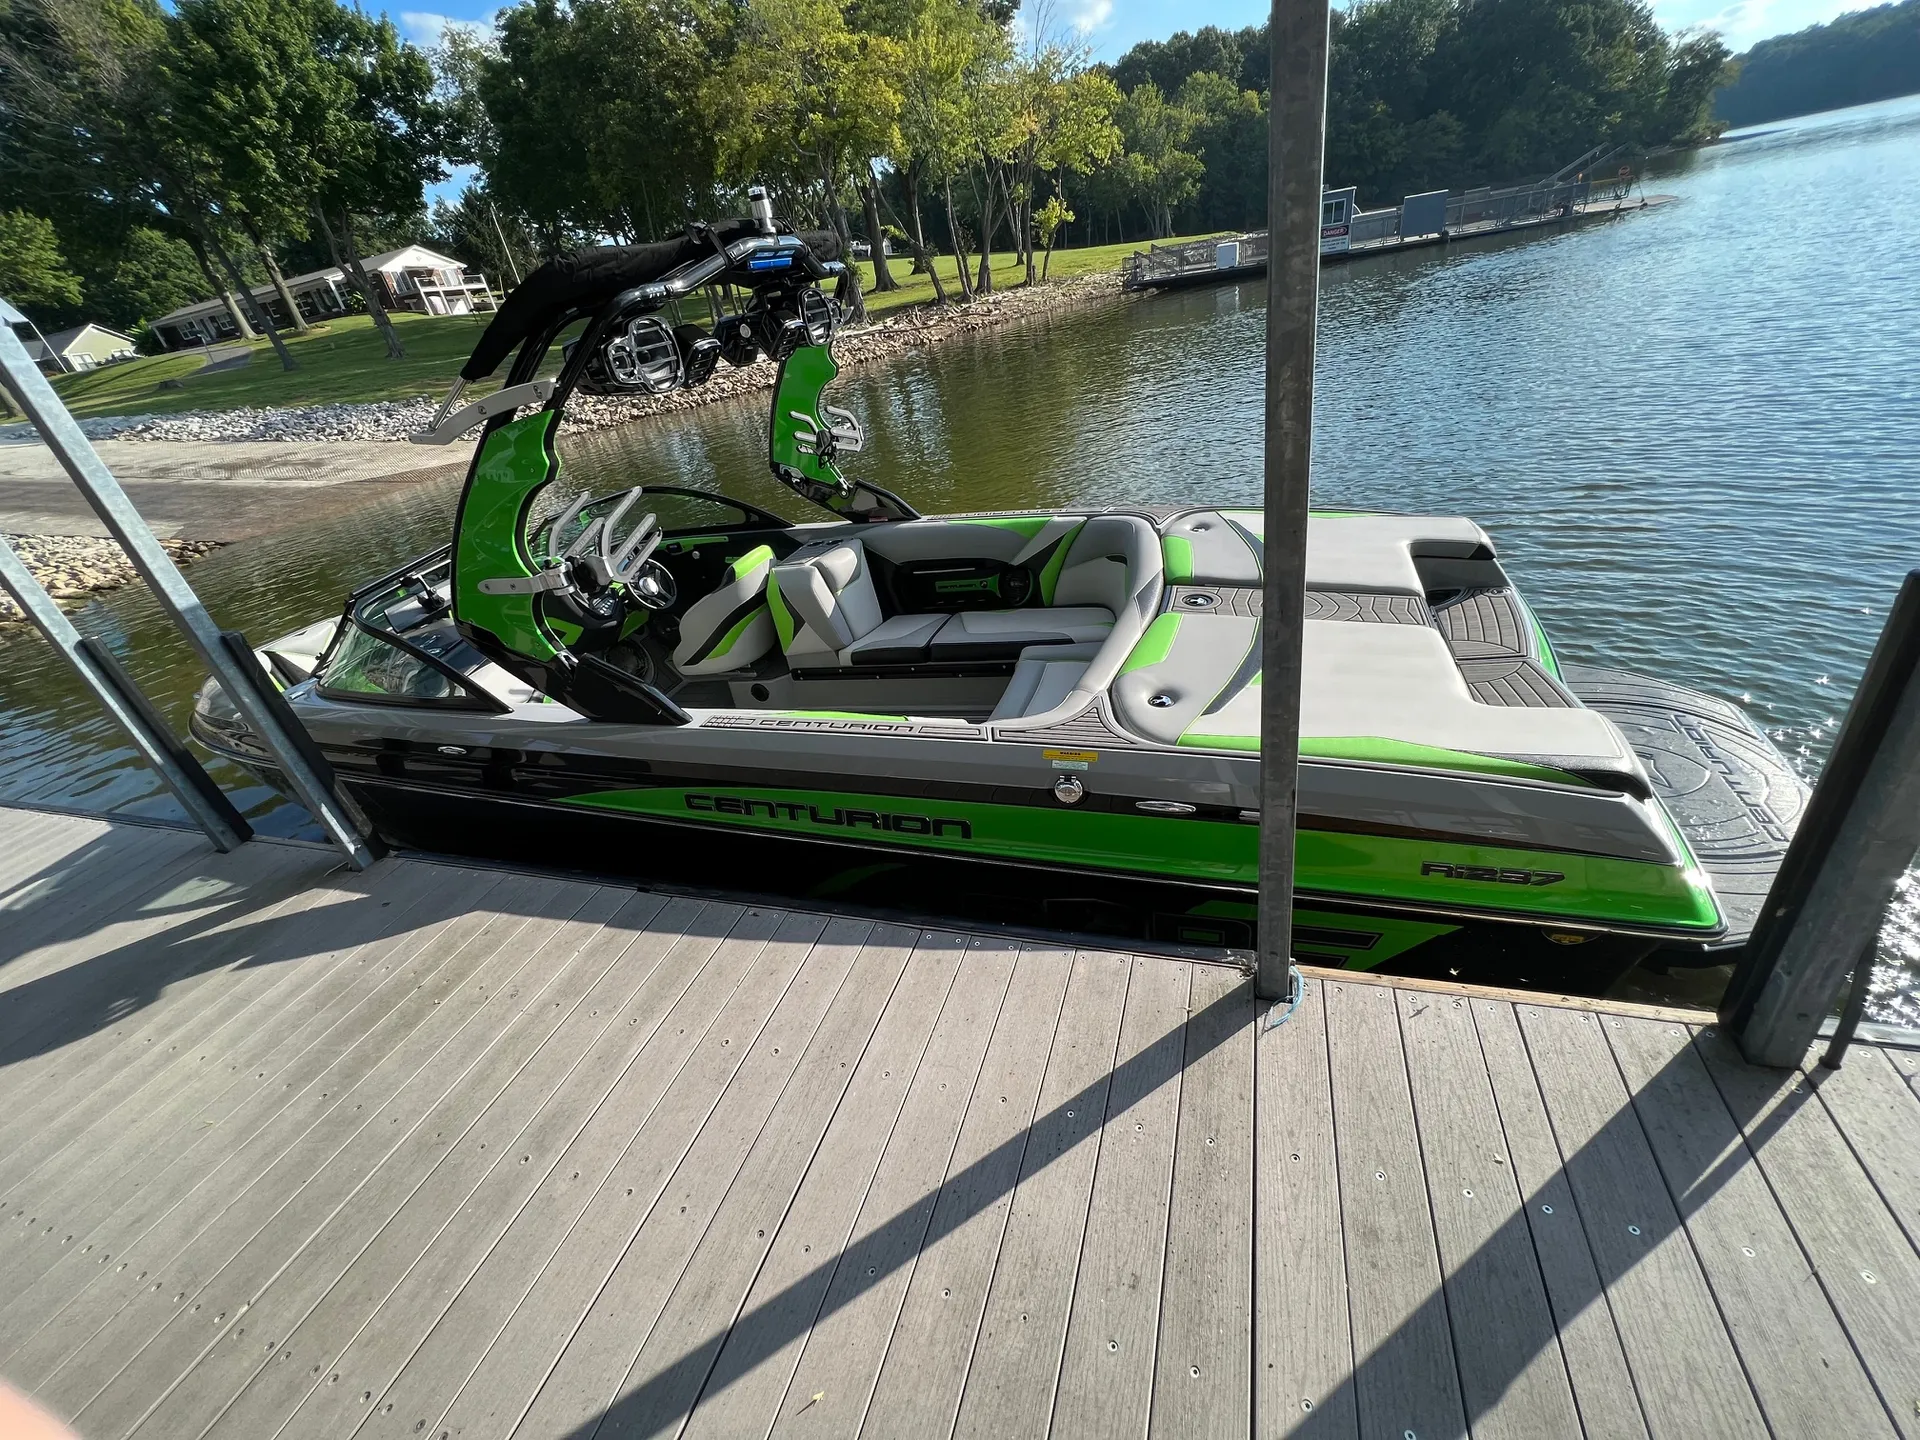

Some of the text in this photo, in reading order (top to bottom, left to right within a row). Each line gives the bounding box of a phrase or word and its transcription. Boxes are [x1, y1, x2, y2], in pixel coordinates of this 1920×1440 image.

[1323, 228, 1344, 237] DANGER
[758, 719, 914, 732] CENTURION
[684, 793, 972, 839] CENTURION
